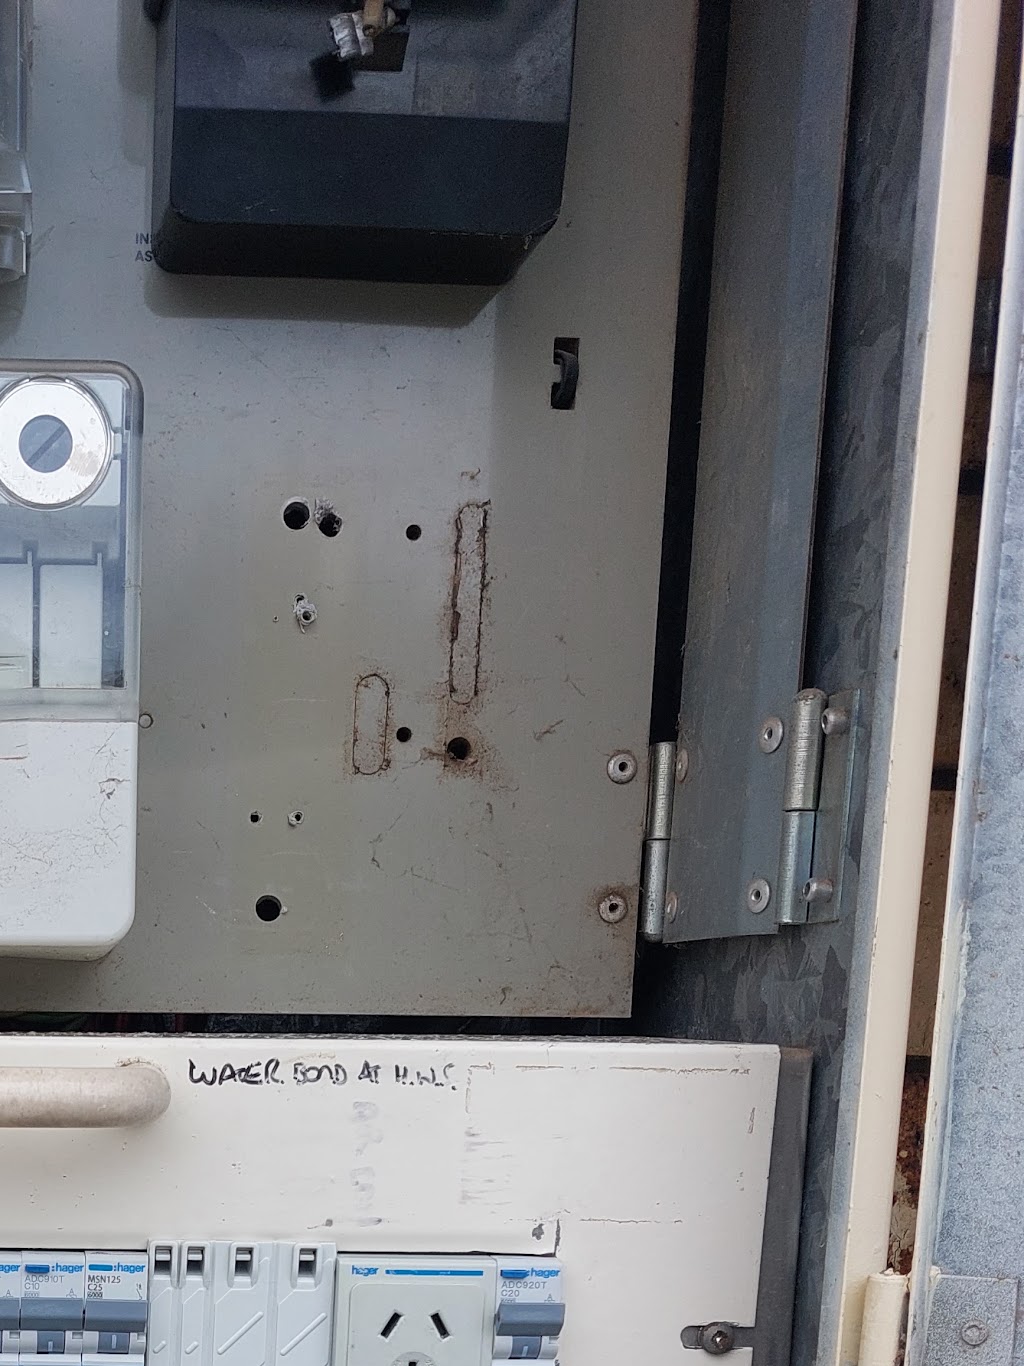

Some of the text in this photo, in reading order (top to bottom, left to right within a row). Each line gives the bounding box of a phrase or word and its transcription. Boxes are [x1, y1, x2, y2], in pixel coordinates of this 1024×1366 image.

[357, 1060, 381, 1085] AT
[87, 1275, 121, 1284] MSN125
[87, 1283, 103, 1291] C25
